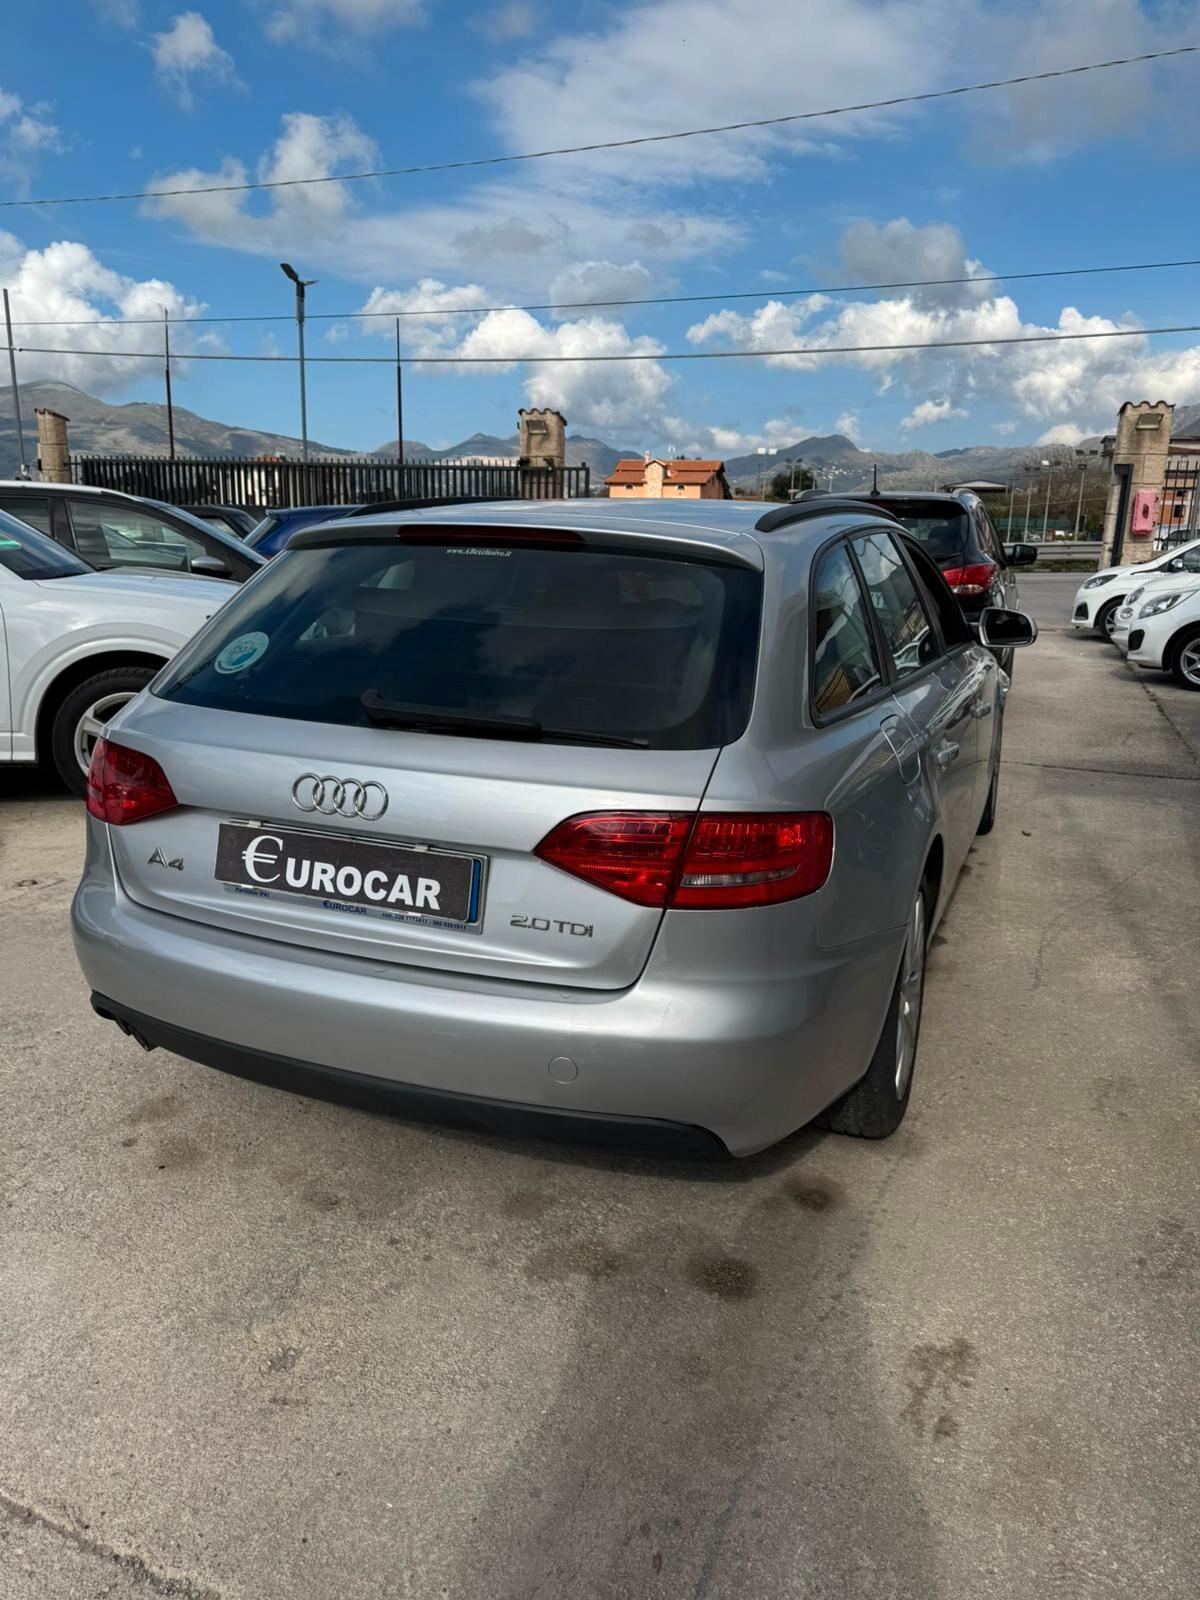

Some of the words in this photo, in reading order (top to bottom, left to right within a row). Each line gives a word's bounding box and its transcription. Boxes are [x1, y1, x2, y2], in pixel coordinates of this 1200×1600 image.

[147, 847, 184, 871] A4
[510, 914, 550, 931] 2.0
[553, 919, 594, 938] TDI
